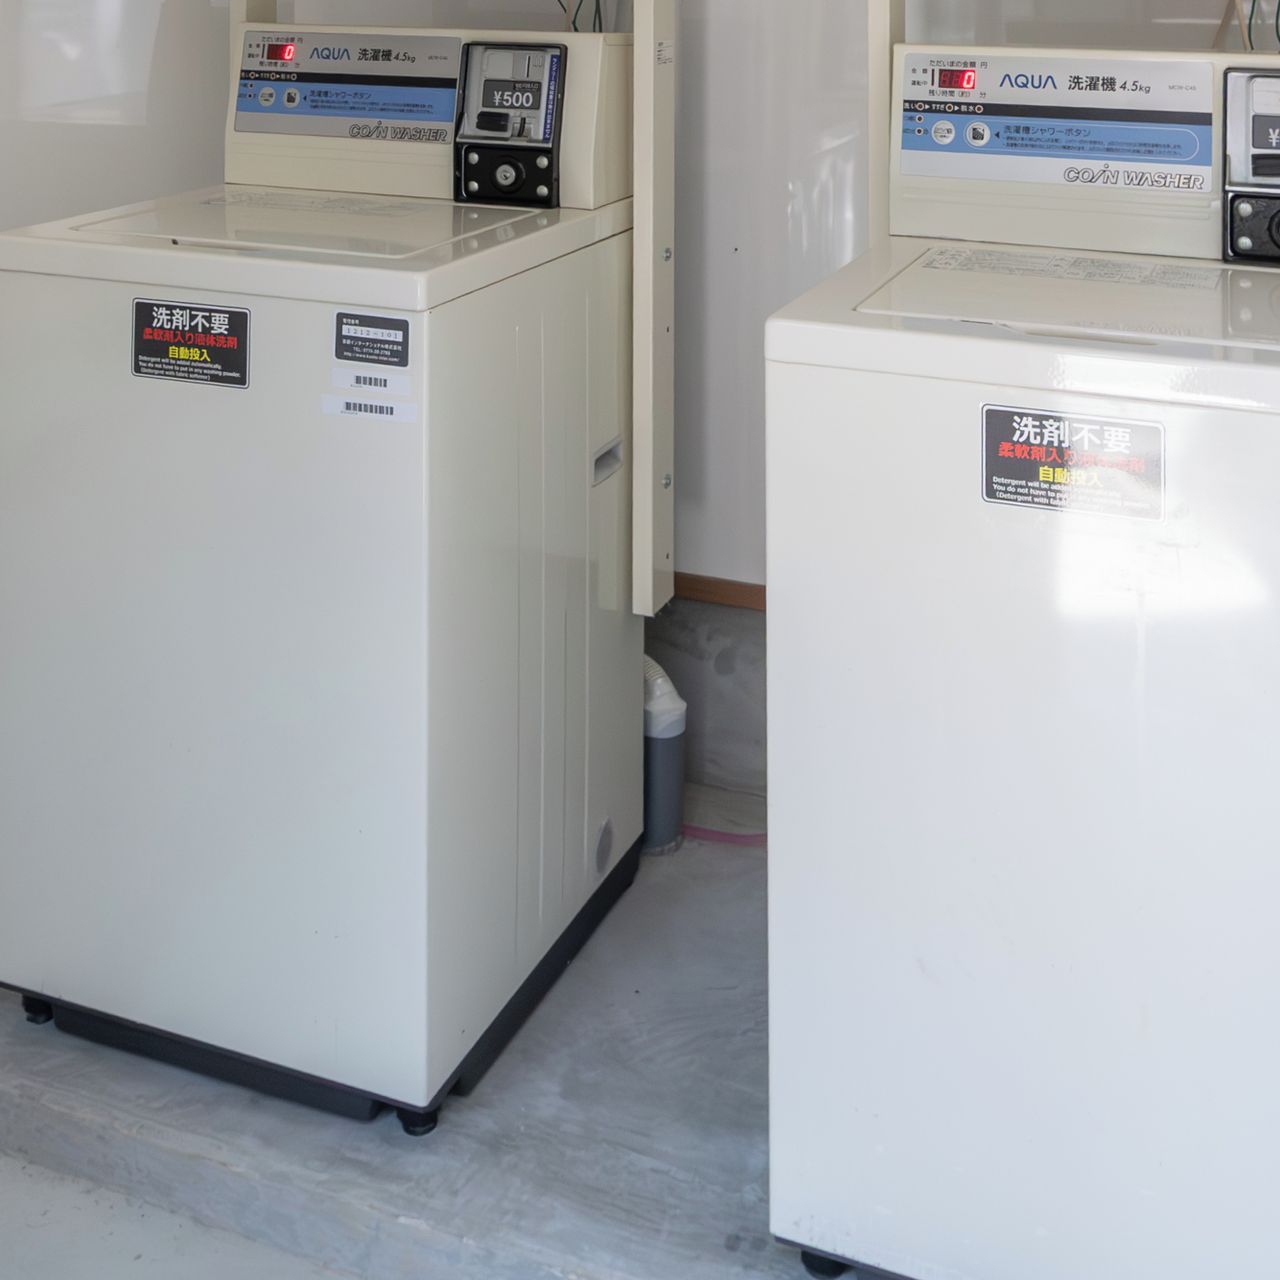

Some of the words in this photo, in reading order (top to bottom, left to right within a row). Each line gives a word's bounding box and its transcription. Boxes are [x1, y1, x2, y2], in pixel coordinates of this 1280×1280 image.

[285, 46, 294, 59] 0
[310, 48, 350, 61] AQUA
[357, 48, 392, 62] 洗濯機
[393, 52, 416, 64] 4.5kg
[929, 59, 976, 68] ただいまの金額
[962, 71, 975, 88] 0
[999, 73, 1057, 90] AQUA
[1068, 75, 1116, 92] 洗濯機
[1119, 80, 1151, 94] 4.5kg
[493, 91, 533, 107] ¥500
[391, 128, 447, 141] WASHER
[1004, 125, 1091, 137] 洗濯槽シャワーボタン
[1123, 170, 1204, 190] WASHER
[152, 306, 229, 334] 洗剤不要
[168, 346, 211, 361] 自動投入
[1012, 415, 1132, 454] 洗剤不要
[992, 476, 1026, 488] Detergent
[1027, 480, 1039, 488] will
[1039, 466, 1104, 488] 自動投入
[992, 483, 1005, 491] You
[1017, 486, 1029, 494] not
[1030, 487, 1046, 495] have
[996, 491, 1033, 503] (Detergent
[1034, 495, 1049, 504] with
